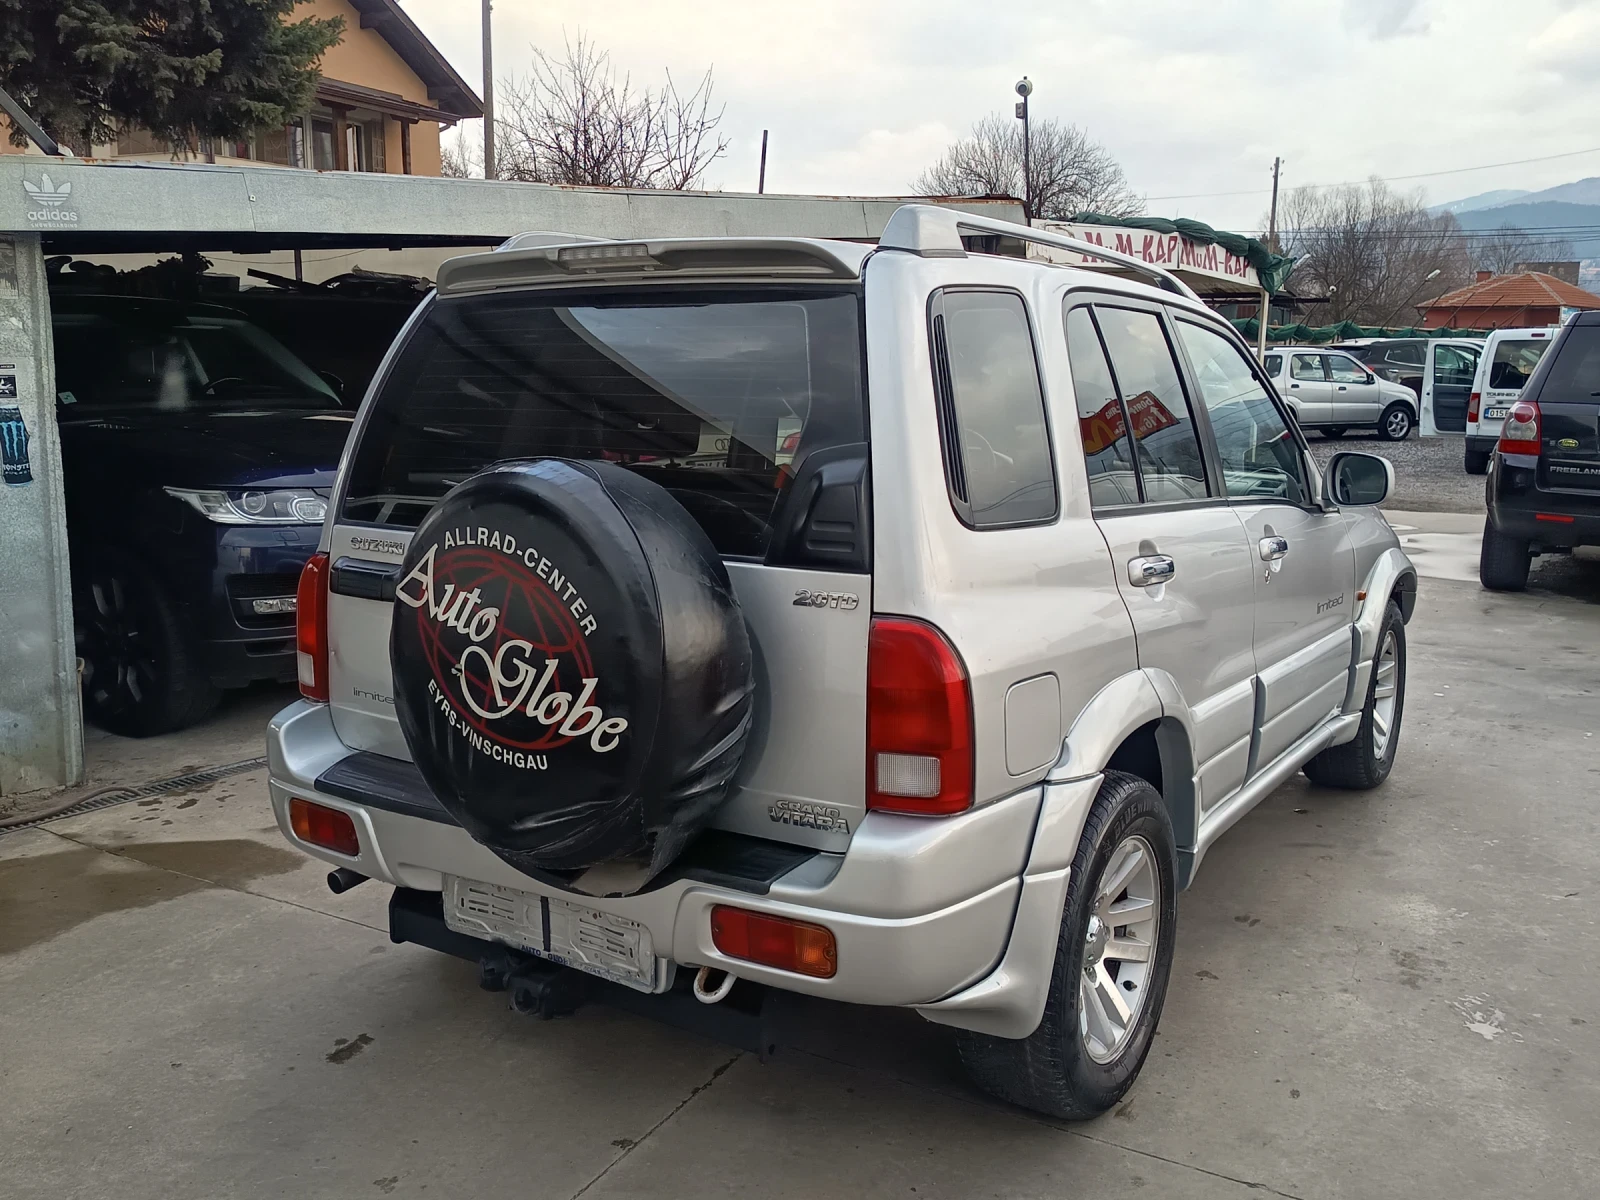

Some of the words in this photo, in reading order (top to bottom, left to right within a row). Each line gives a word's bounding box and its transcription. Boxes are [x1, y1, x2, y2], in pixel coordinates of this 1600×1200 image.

[27, 208, 78, 221] adidas
[350, 536, 405, 555] SUZUKI
[395, 543, 500, 642] Auto
[444, 526, 598, 637] ALLRAD-CENTER
[353, 686, 395, 704] limite
[456, 639, 629, 753] Globe
[427, 678, 549, 770] EYRS-VINSCHGAU
[767, 806, 850, 834] VITARA
[776, 800, 840, 818] GRAND
